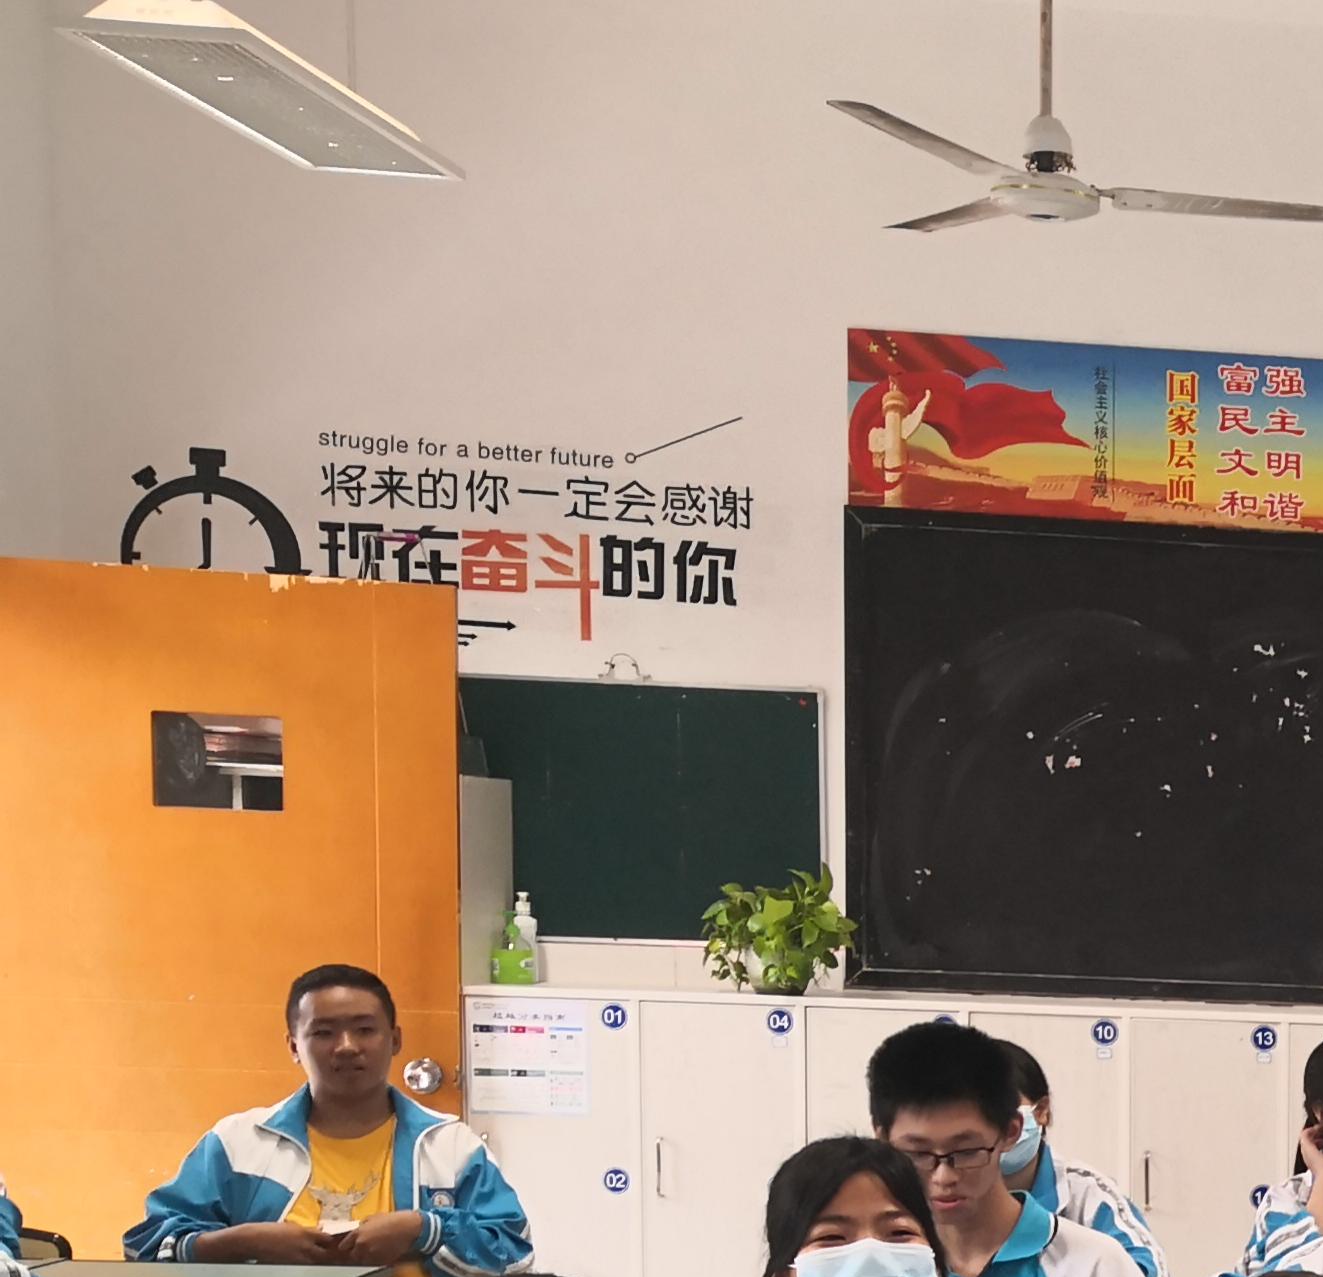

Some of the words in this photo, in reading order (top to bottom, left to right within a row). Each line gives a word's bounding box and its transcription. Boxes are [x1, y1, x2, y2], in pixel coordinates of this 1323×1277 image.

[1217, 363, 1306, 398] 富强
[1165, 370, 1201, 505] 国家层面
[1215, 404, 1307, 439] 民主
[318, 429, 409, 456] struggle
[417, 436, 448, 458] for
[456, 443, 470, 459] a
[477, 441, 541, 466] better
[549, 445, 615, 469] future
[1214, 448, 1303, 482] 文明
[320, 462, 754, 531] 将来的你一定会感谢
[1212, 489, 1302, 523] 和谐
[602, 1009, 623, 1025] 01
[769, 1014, 790, 1030] 04
[1096, 1024, 1114, 1040] 10
[1255, 1031, 1273, 1046] 13
[605, 1173, 627, 1188] 02
